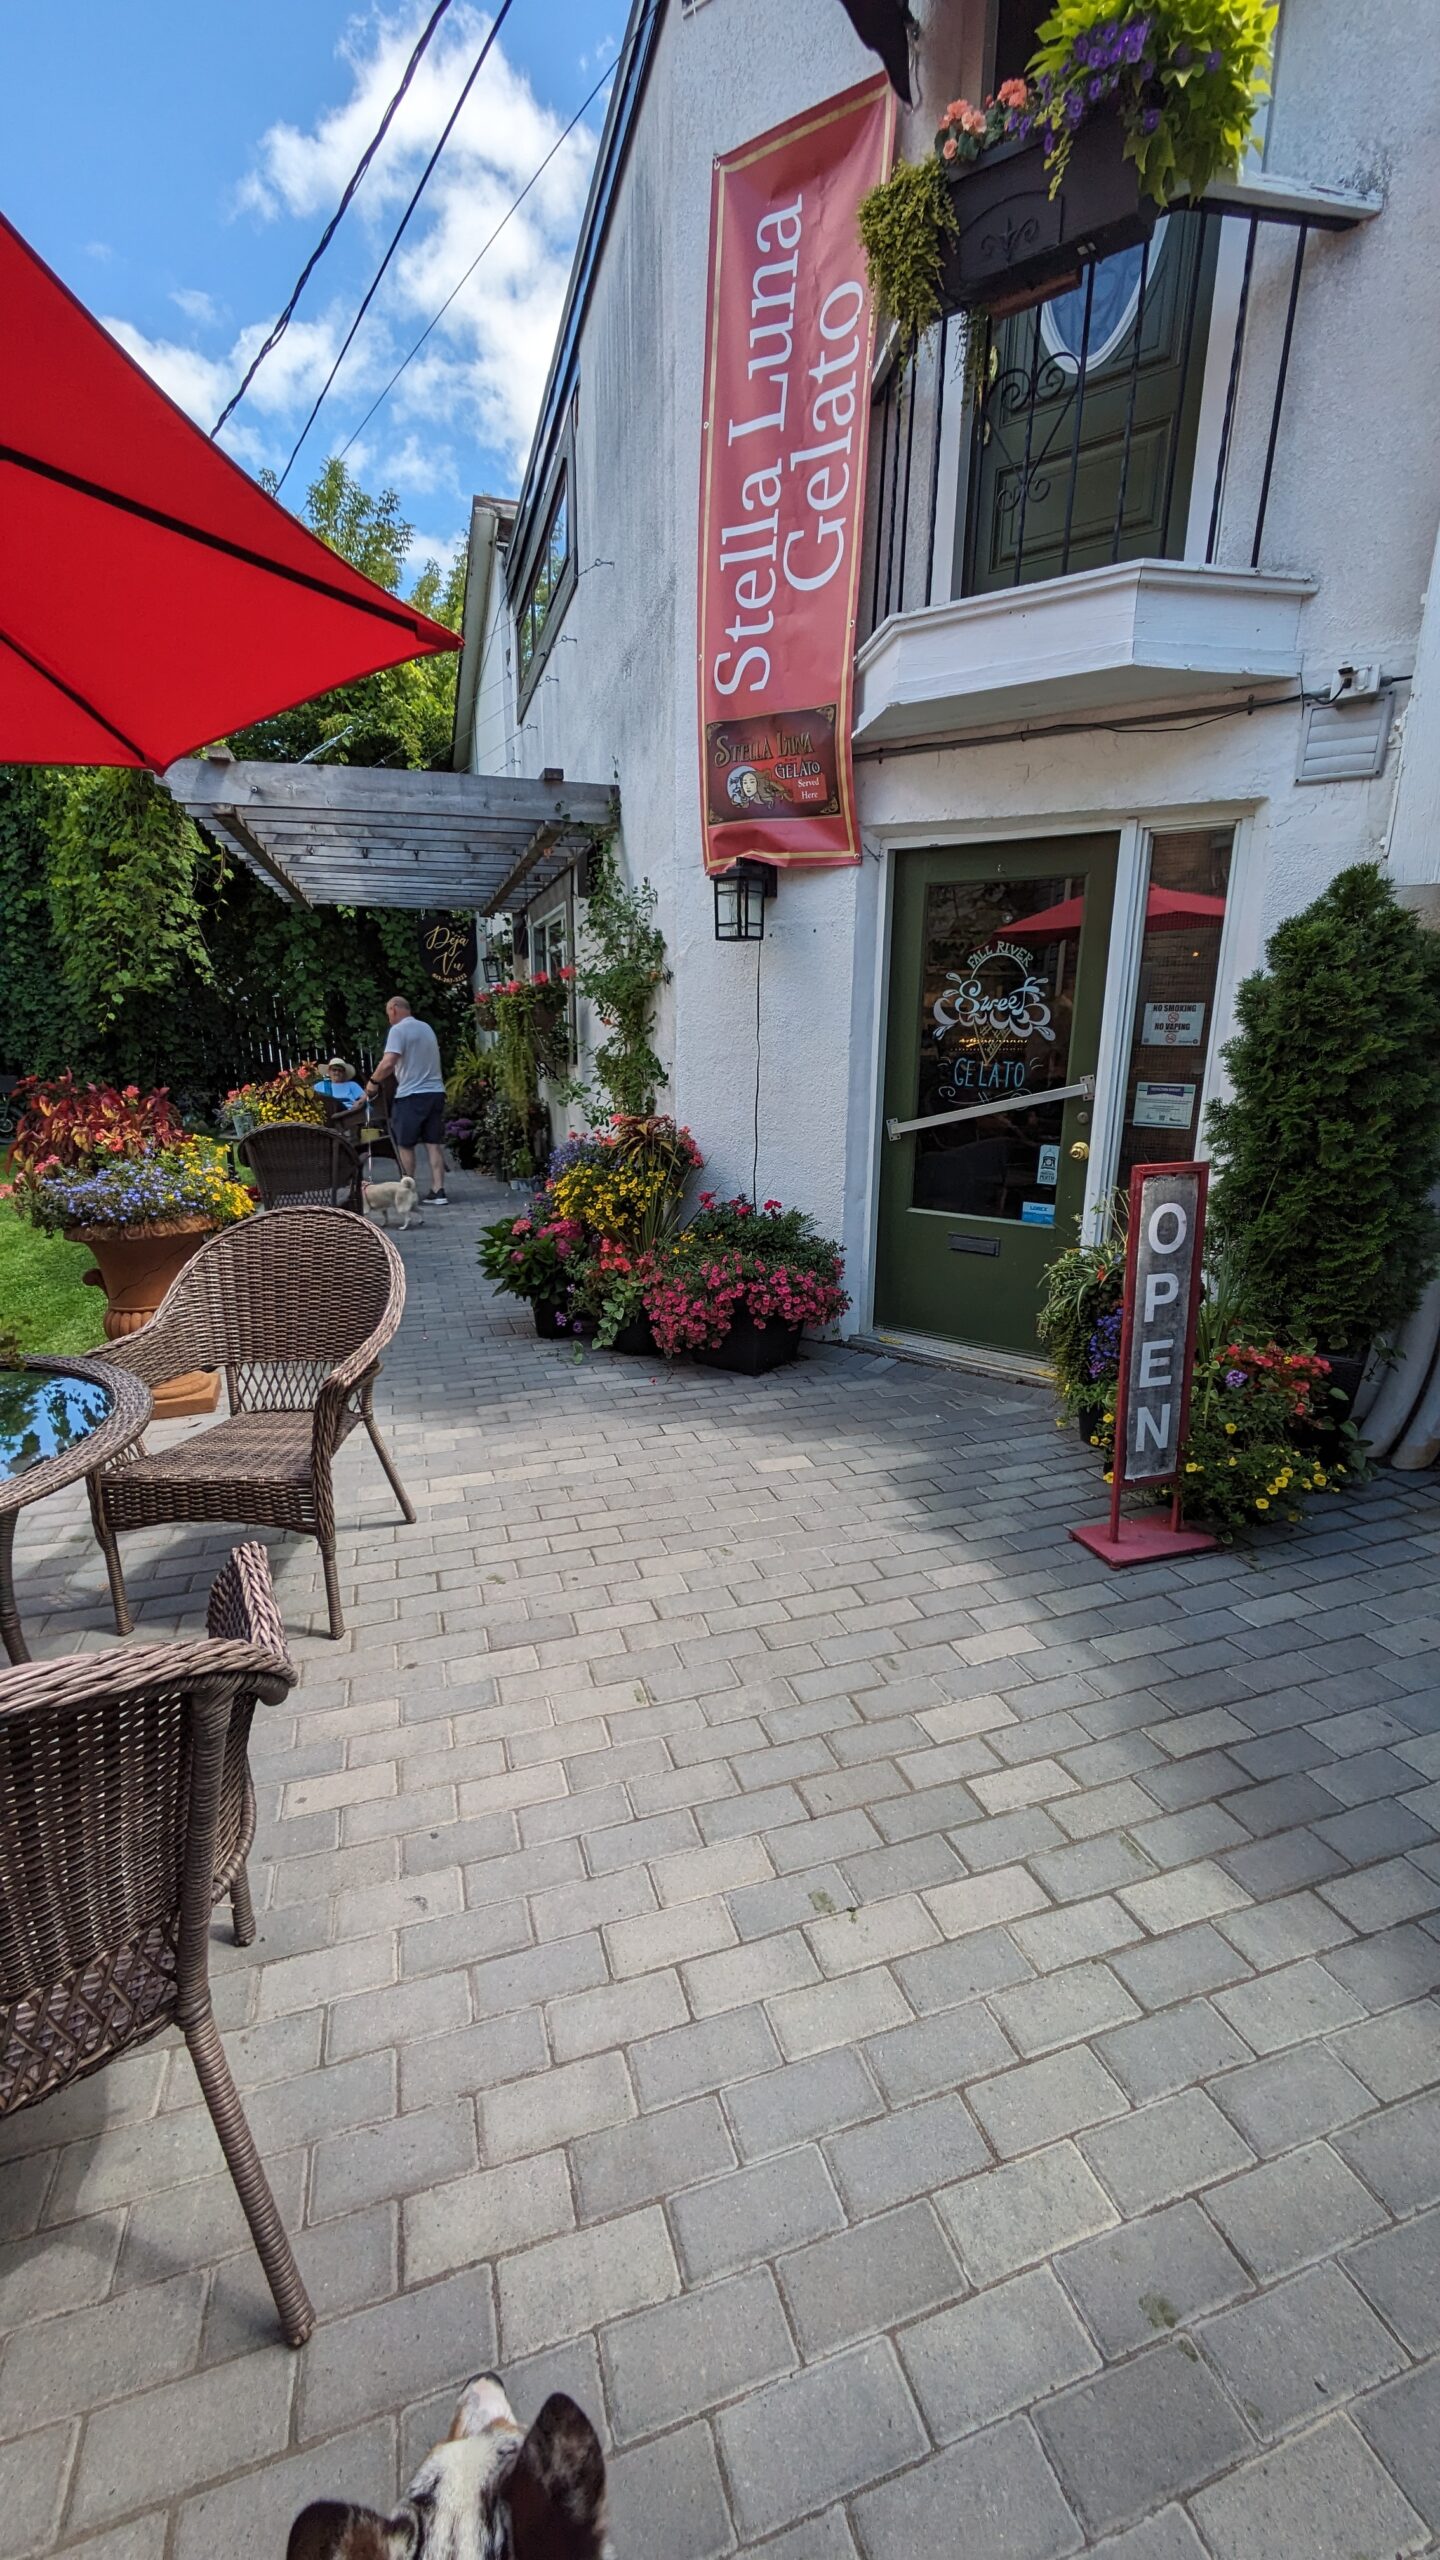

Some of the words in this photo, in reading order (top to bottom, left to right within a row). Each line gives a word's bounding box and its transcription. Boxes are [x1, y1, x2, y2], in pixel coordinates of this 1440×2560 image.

[728, 192, 803, 447] Luna
[782, 280, 864, 591] Gelato
[713, 458, 783, 696] Stella
[774, 760, 821, 779] GELATO
[797, 778, 820, 788] Served
[801, 791, 819, 800] Here
[432, 950, 465, 976] Vu
[967, 946, 993, 969] FALL
[997, 940, 1034, 968] RIVER
[954, 976, 1041, 1016] Sweet
[1153, 1004, 1163, 1012] NO
[1164, 1004, 1197, 1012] SMOKING
[1154, 1022, 1164, 1031] NO
[1165, 1023, 1191, 1031] VAPING
[953, 1057, 1025, 1088] GELATO
[1134, 1202, 1188, 1453] OPEN
